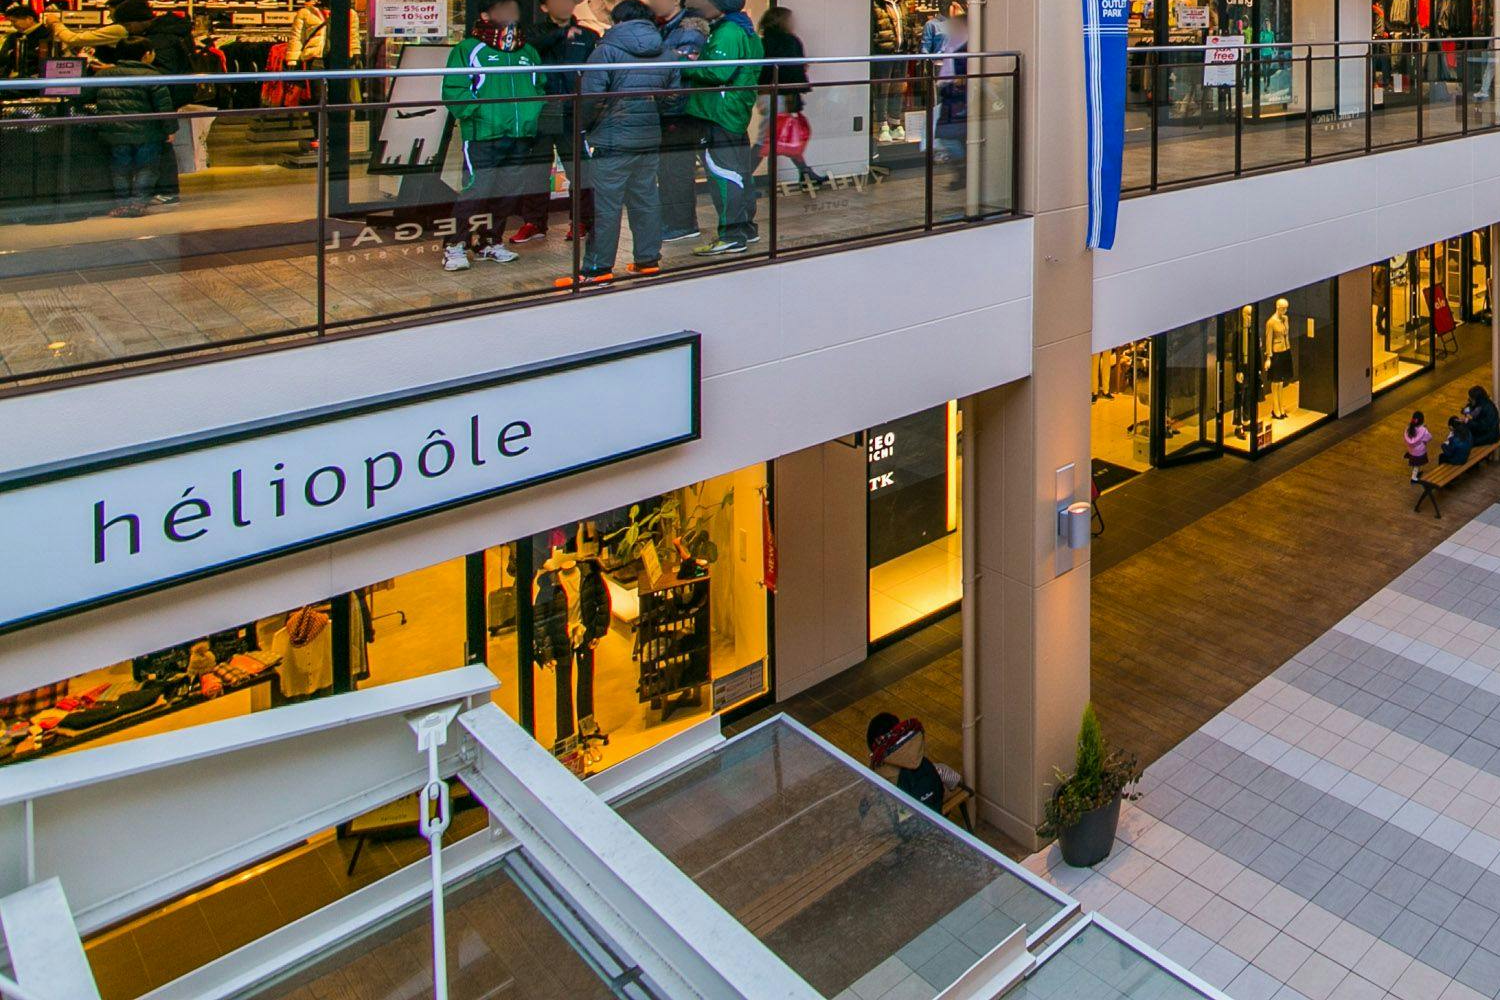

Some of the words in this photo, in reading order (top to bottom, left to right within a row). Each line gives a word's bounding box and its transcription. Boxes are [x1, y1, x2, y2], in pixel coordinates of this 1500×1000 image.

[1102, 0, 1127, 9] OUTLET
[1102, 9, 1122, 18] PARK
[1213, 52, 1235, 61] free
[868, 471, 895, 492] TK
[93, 414, 532, 564] héliopôle
